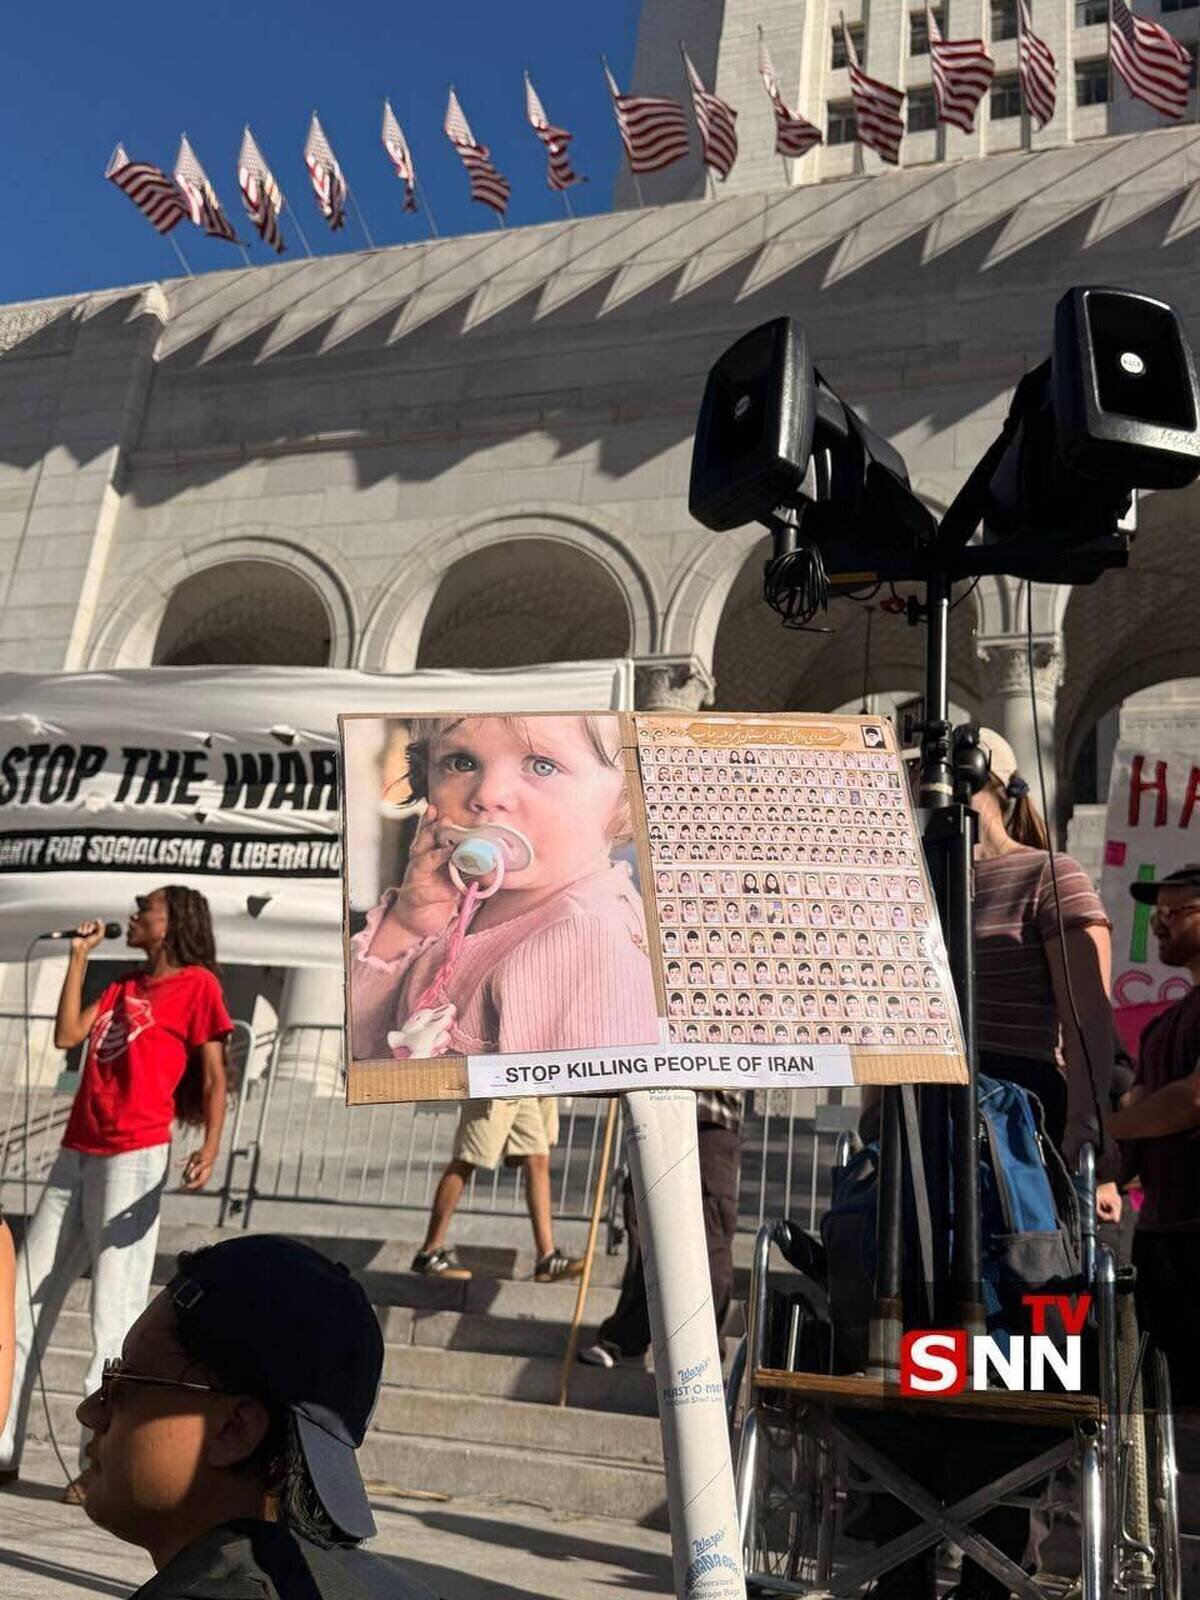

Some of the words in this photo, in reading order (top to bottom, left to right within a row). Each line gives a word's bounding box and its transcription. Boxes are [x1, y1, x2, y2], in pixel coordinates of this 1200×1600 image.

[0, 744, 107, 805] STOP
[114, 747, 208, 804] THE
[219, 751, 338, 811] WAR
[0, 837, 45, 865] ARTY
[45, 836, 86, 864] FOR
[87, 836, 205, 867] SOCIALISM
[207, 843, 224, 869] &
[506, 1065, 560, 1083] STOP
[567, 1058, 648, 1078] KILLING
[654, 1056, 732, 1072] PEOPLE
[737, 1056, 762, 1072] OF
[768, 1056, 814, 1072] IRAN
